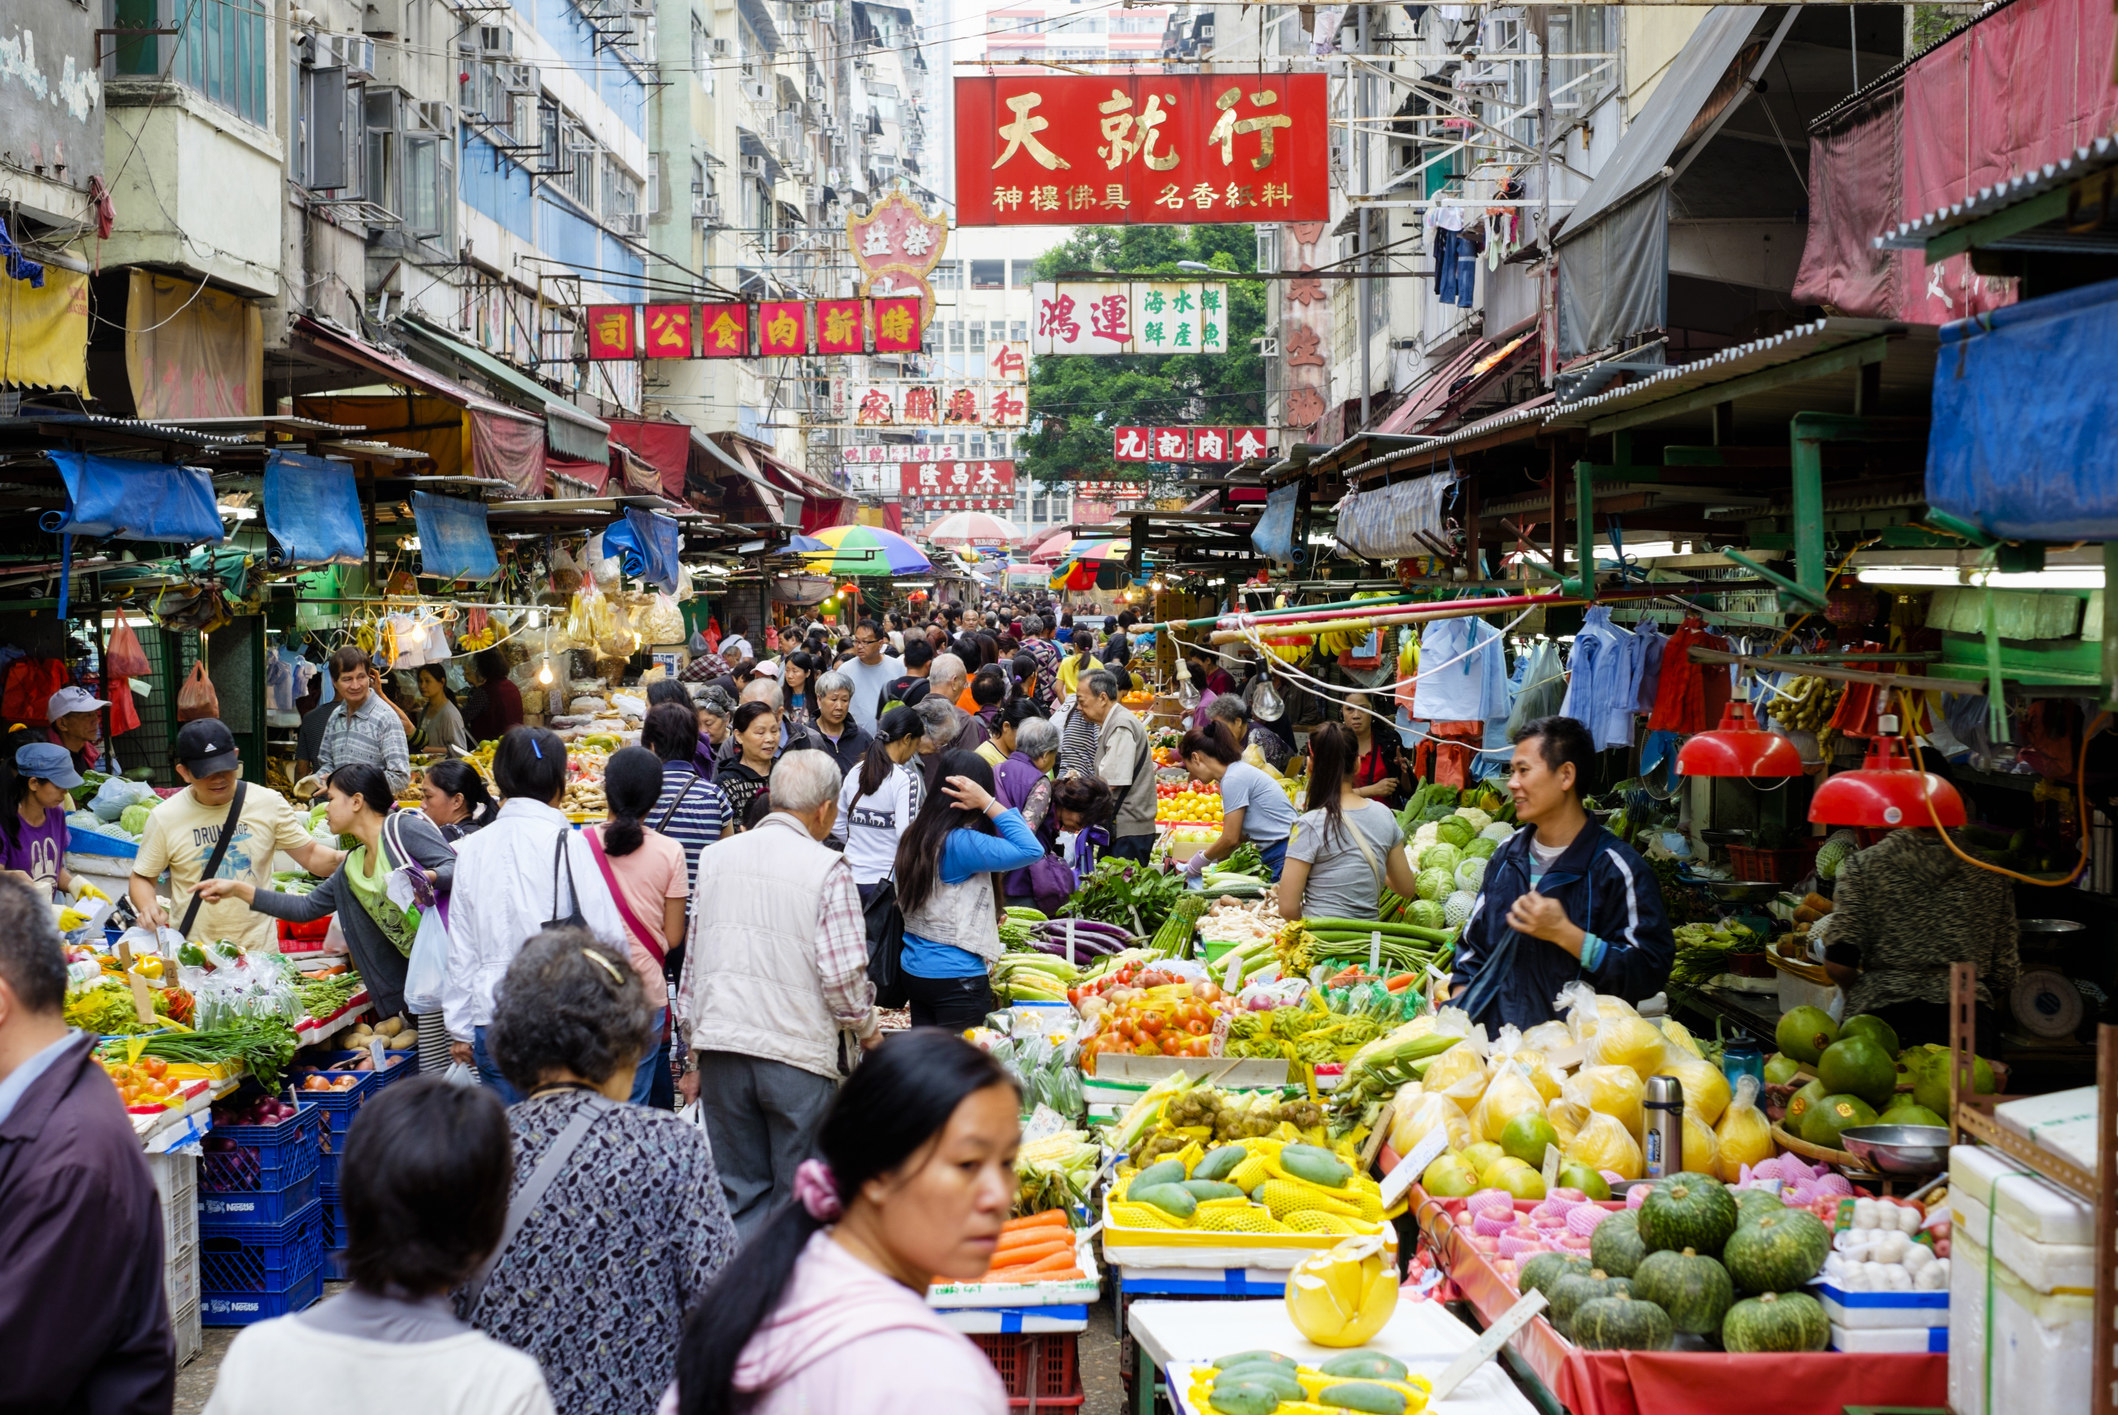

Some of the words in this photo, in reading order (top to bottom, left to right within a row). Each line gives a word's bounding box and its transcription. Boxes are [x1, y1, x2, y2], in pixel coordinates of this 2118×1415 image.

[991, 86, 1292, 171] 天就行
[1155, 181, 1293, 210] 名香紙料
[1039, 293, 1134, 344] 鴻運
[1118, 430, 1267, 460] 九記肉食
[226, 1202, 255, 1212] Nestlé
[231, 1302, 259, 1311] Nestlé
